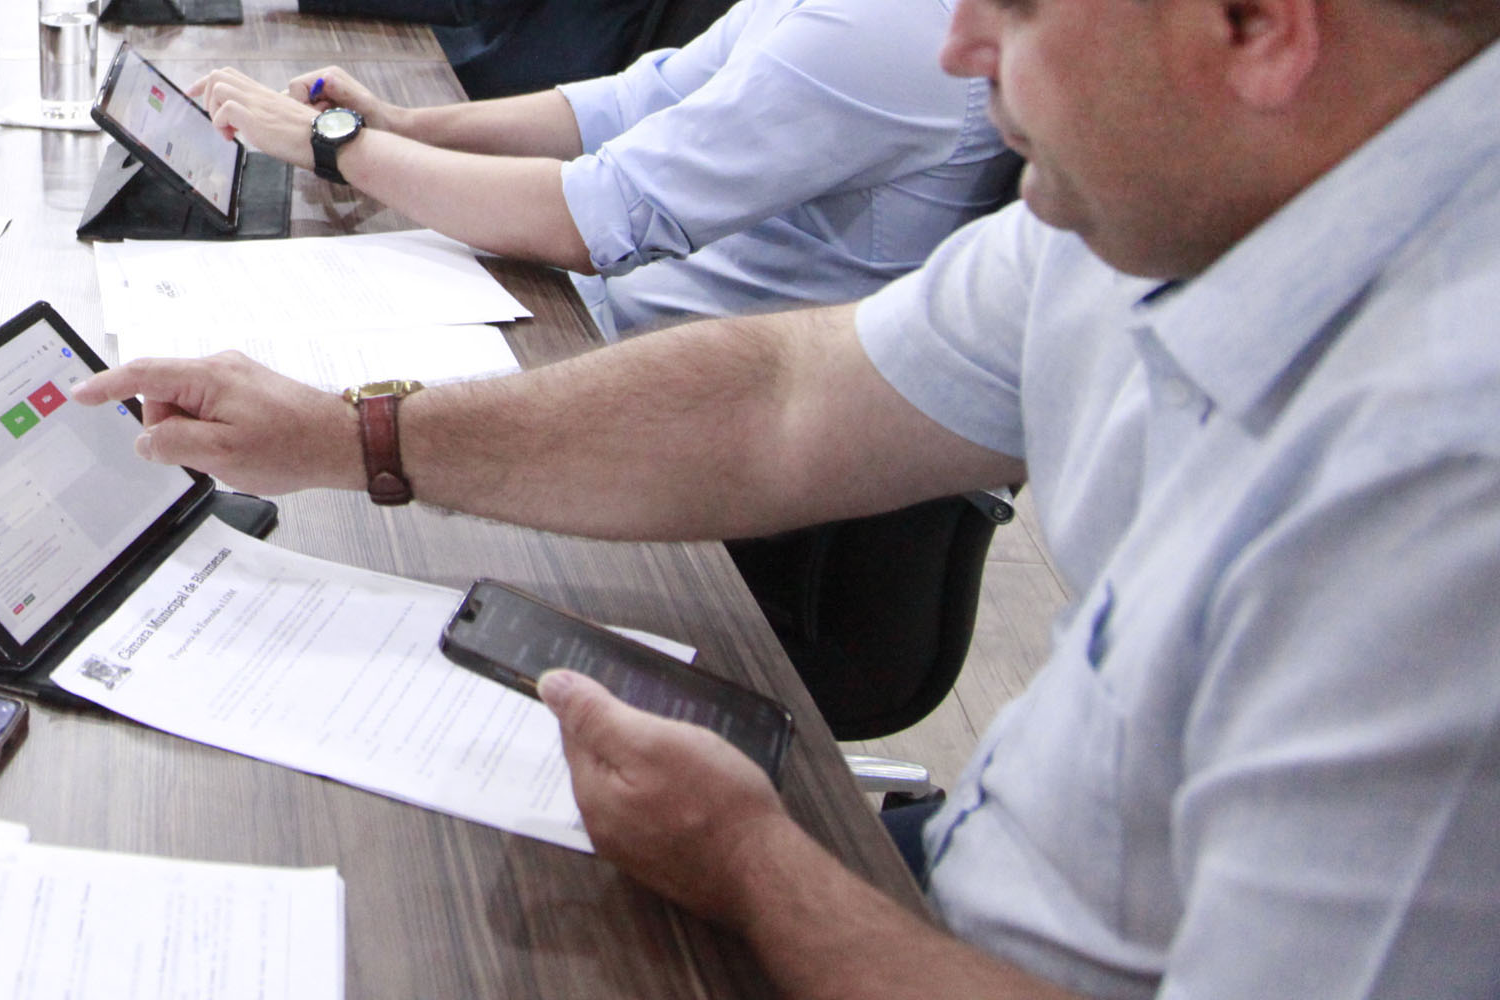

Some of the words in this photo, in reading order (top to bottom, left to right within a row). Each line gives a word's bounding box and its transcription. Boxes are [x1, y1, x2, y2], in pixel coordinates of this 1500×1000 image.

[190, 544, 233, 585] Blumenau
[183, 579, 199, 593] de
[146, 590, 190, 631] Municipal
[118, 629, 153, 660] Câmara
